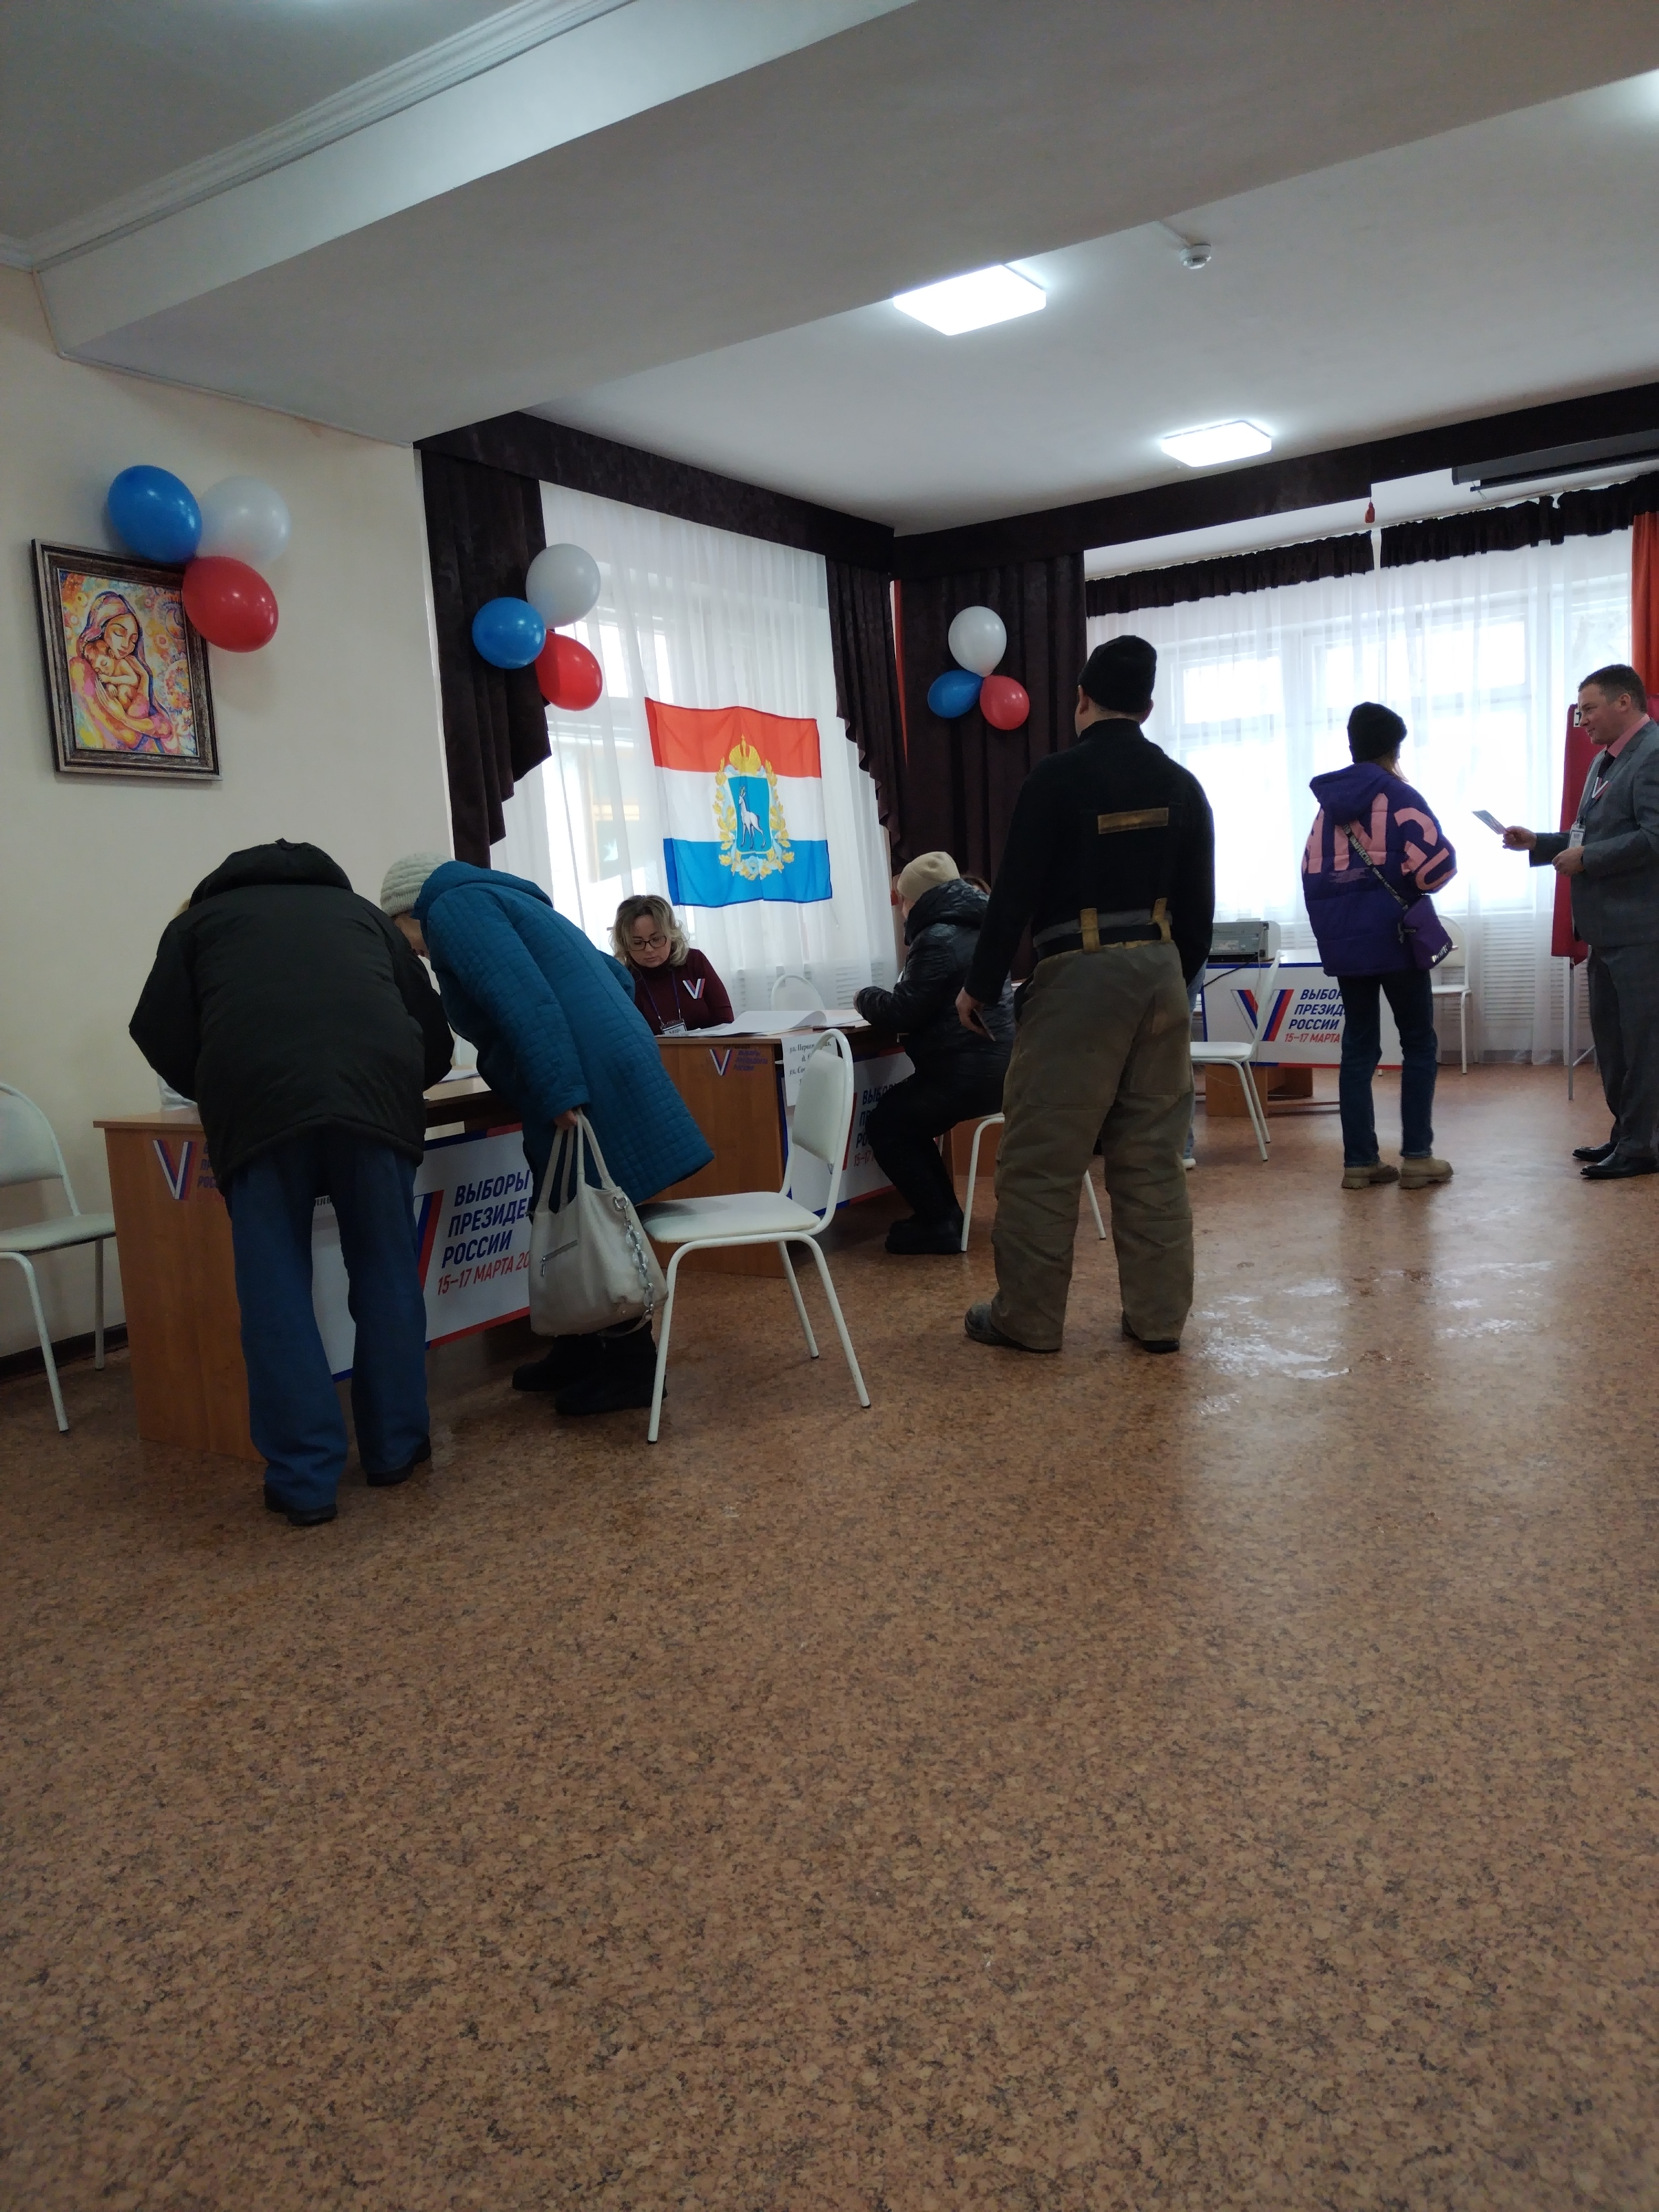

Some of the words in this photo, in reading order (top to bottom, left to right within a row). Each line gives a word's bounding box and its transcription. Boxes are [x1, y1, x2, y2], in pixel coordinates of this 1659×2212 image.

[1294, 1004, 1345, 1016] ПРЕЗИД
[1288, 1019, 1340, 1030] РОССИИ
[1285, 1033, 1310, 1042] 15–17
[1310, 1033, 1340, 1042] МАРТА
[454, 1170, 530, 1207] ВЫБОРЫ
[442, 1229, 513, 1269] РОССИИ
[437, 1268, 472, 1295] 15–17
[473, 1256, 514, 1284] МАРТА
